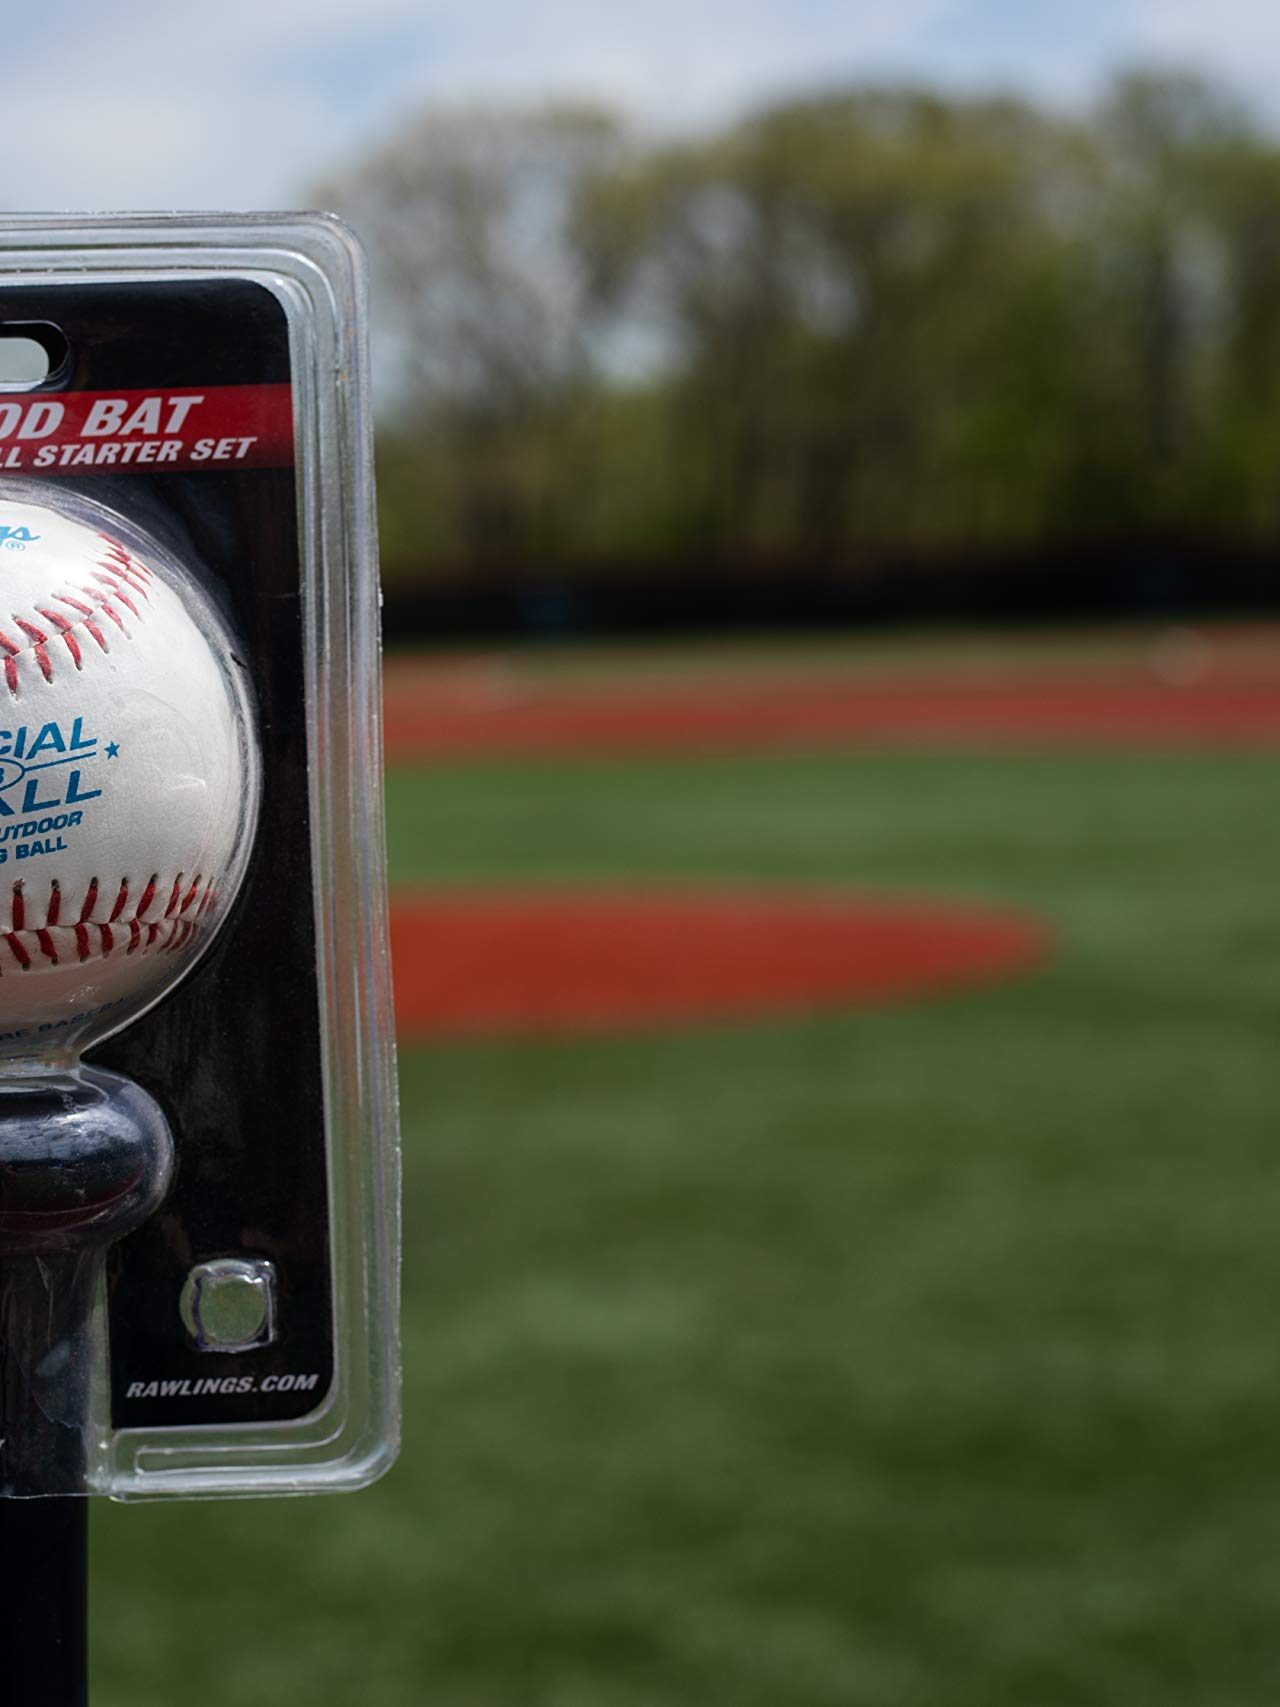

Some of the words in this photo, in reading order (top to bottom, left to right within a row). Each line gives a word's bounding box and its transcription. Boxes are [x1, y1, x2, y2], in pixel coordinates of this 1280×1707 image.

[79, 395, 205, 438] BAT
[34, 440, 181, 467] STARTER
[190, 436, 258, 460] SET
[14, 835, 69, 862] BALL
[126, 1374, 319, 1399] RAWLINGS.COM
